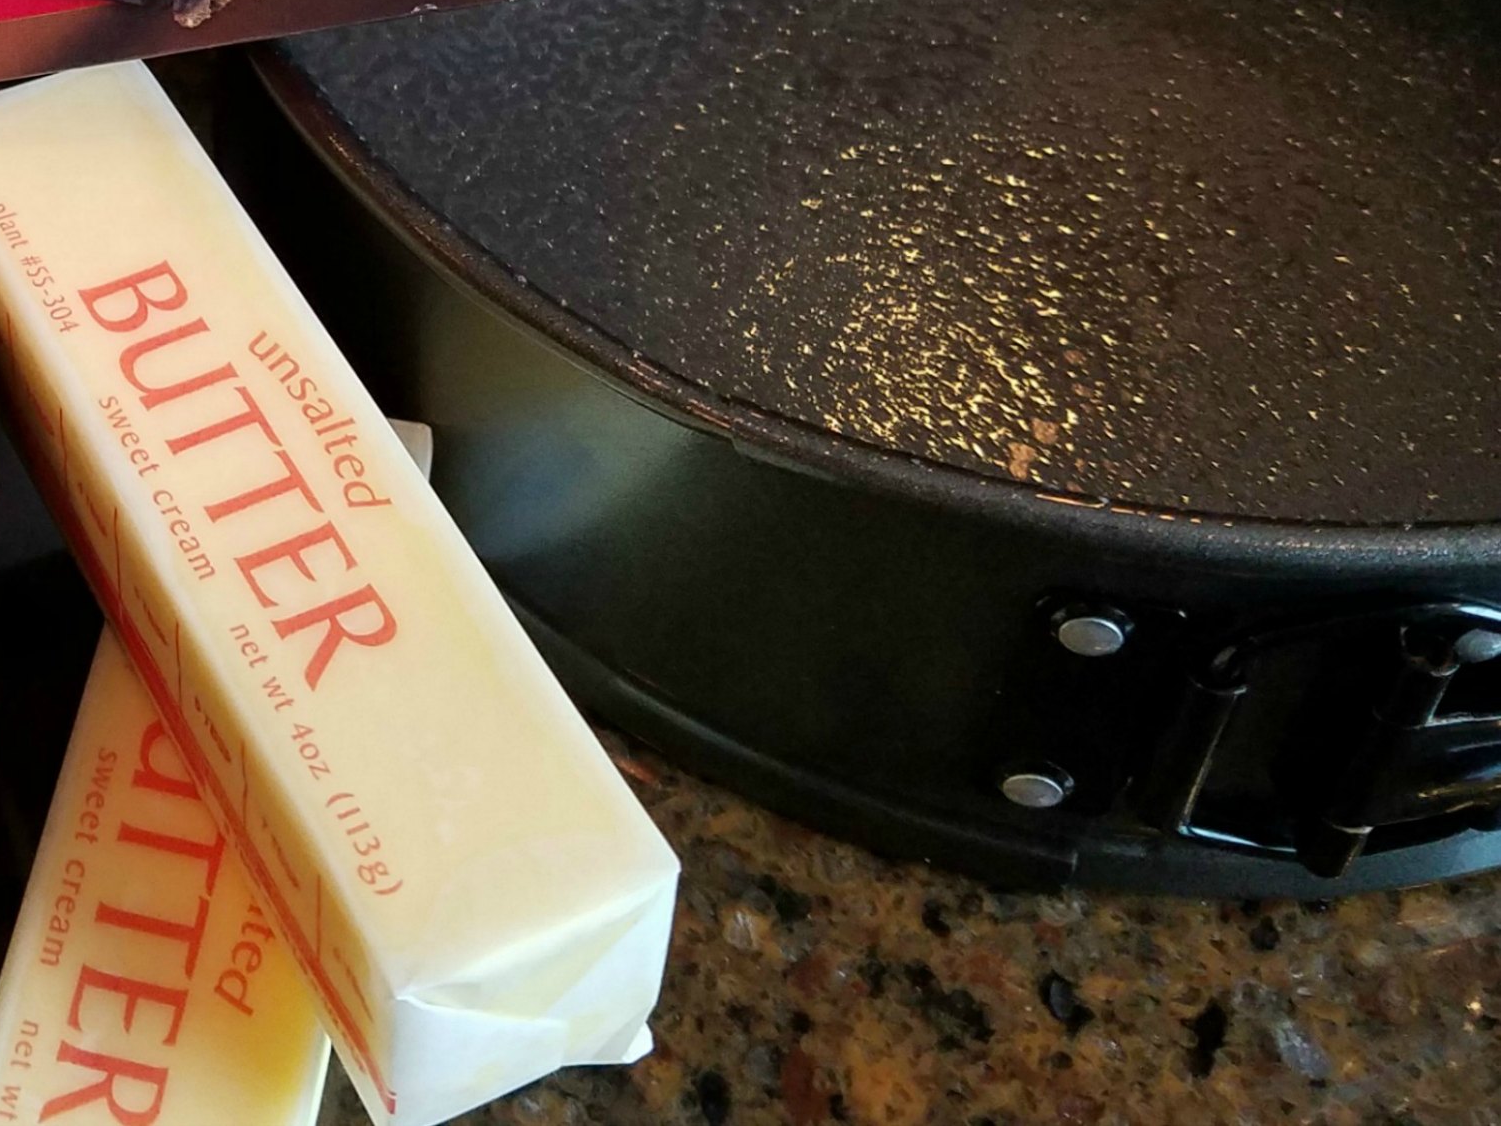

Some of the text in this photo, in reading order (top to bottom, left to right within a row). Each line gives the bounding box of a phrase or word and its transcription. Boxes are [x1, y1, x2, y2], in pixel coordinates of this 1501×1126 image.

[19, 254, 80, 334] #55-304
[77, 259, 397, 692] BUTTER
[247, 330, 393, 511] unsalted
[99, 393, 159, 481] sweet
[154, 486, 217, 582] cream
[228, 622, 269, 672] net
[261, 676, 296, 714] wt
[291, 722, 332, 782] 4oz
[324, 791, 405, 896] (113g)
[74, 746, 118, 844] sweet
[38, 718, 225, 1126] UTTER
[39, 858, 86, 967] cream
[13, 1019, 40, 1071] net
